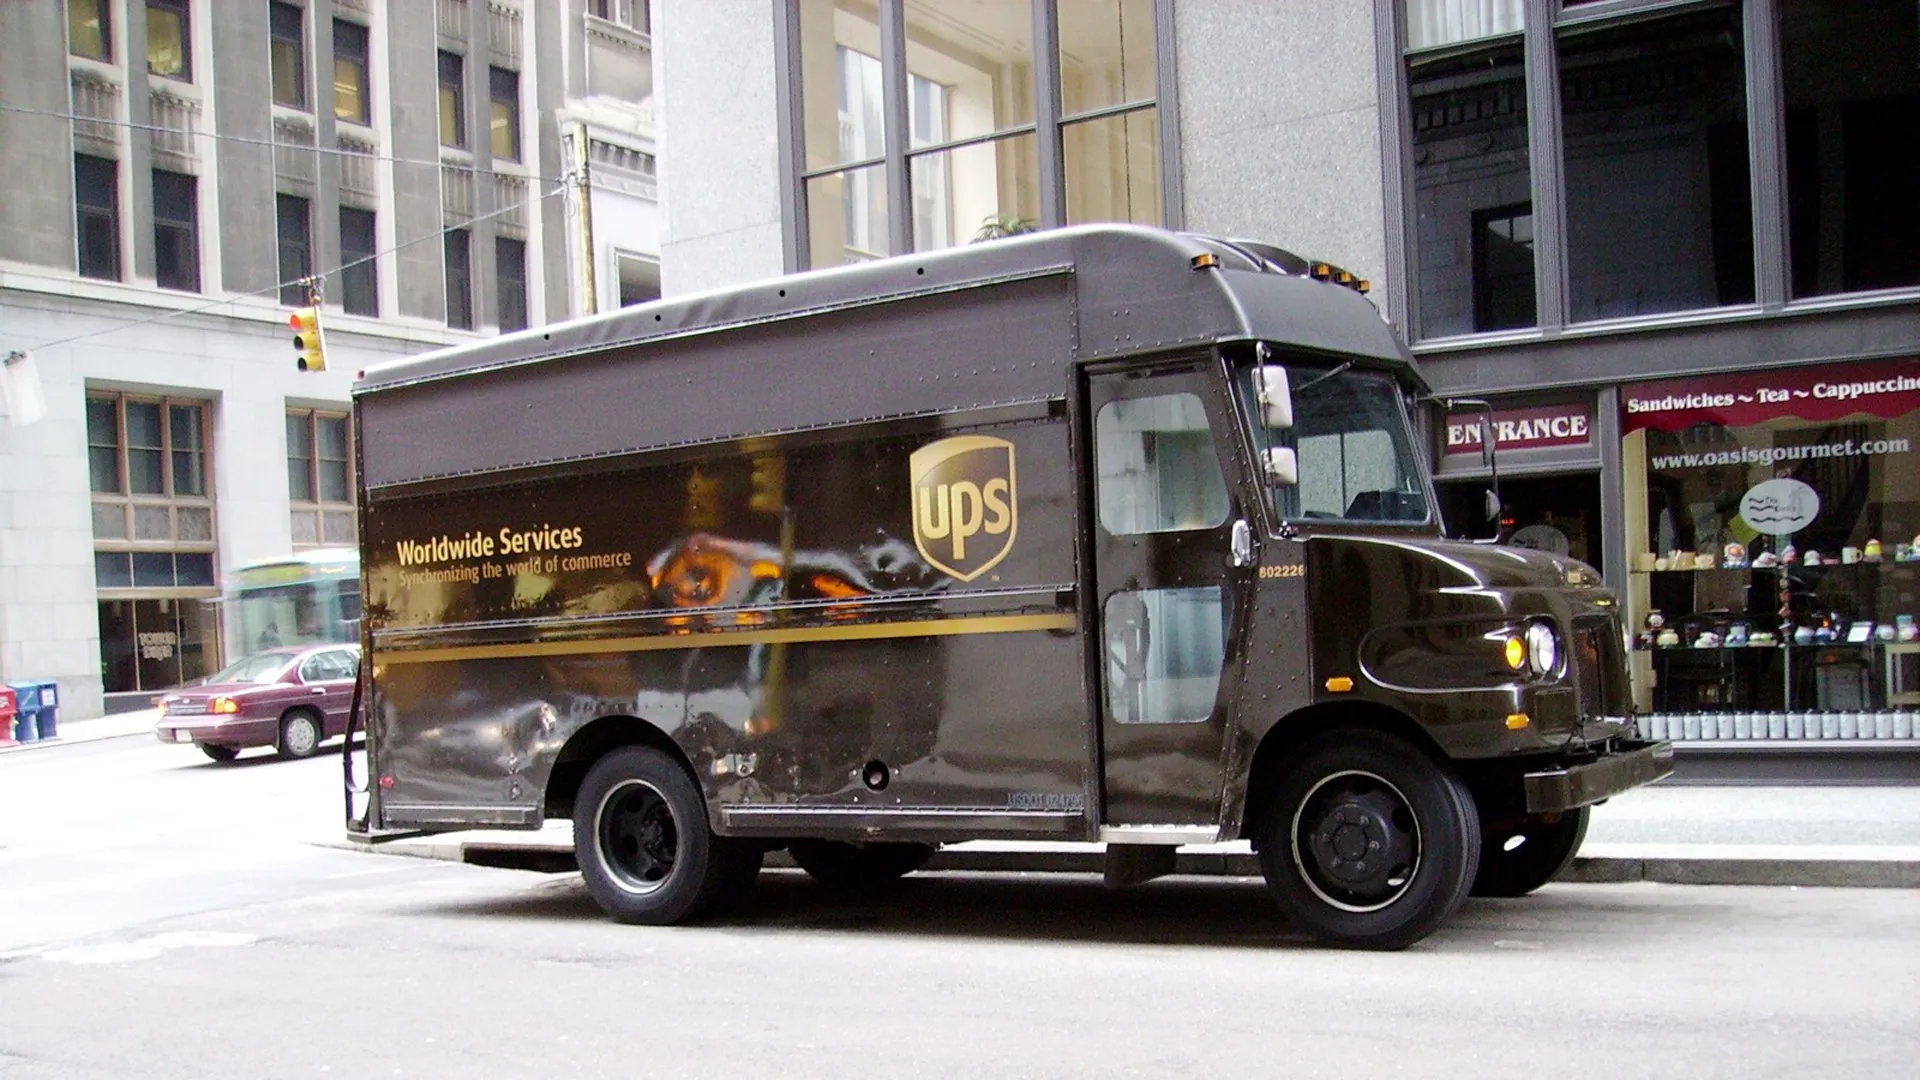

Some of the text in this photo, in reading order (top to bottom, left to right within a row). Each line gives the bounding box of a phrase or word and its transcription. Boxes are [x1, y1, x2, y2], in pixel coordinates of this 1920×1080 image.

[1627, 392, 1735, 413] Sandwiches
[1756, 388, 1790, 404] Tea
[1651, 438, 1909, 470] www.oasisgourmet.com
[396, 523, 583, 566] Worldwide Services
[399, 552, 631, 590] Synchronizing the world of commerce
